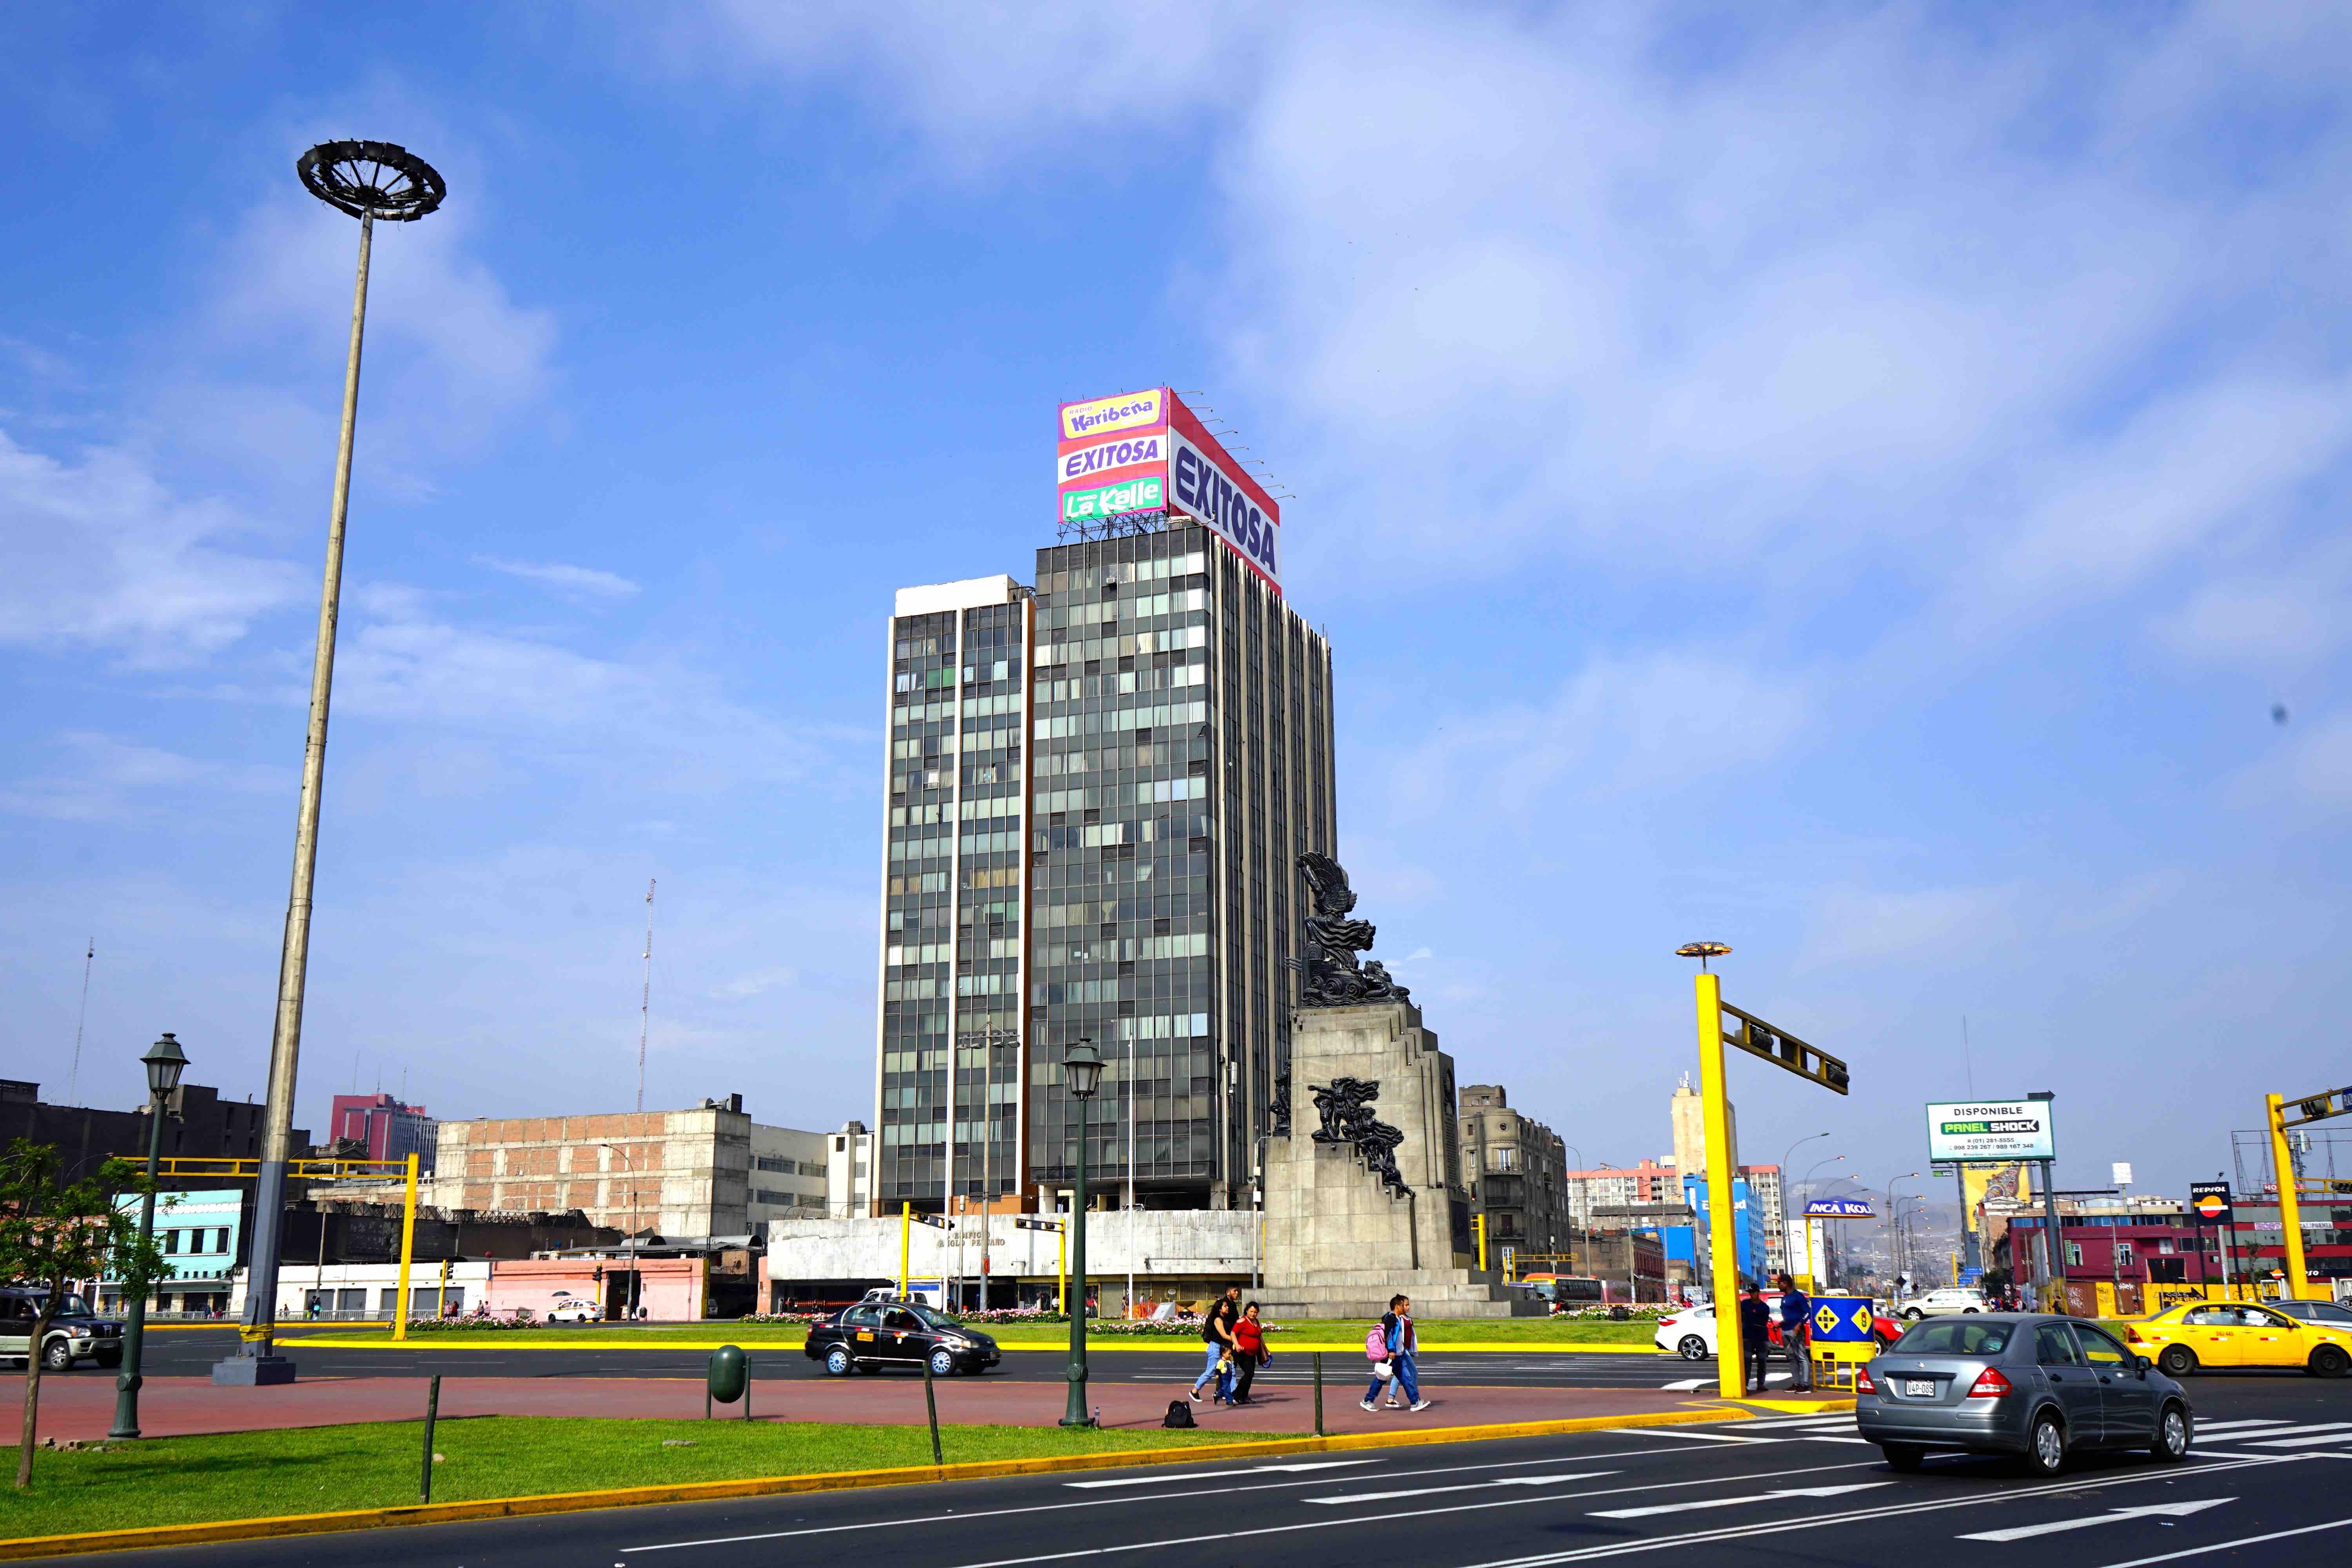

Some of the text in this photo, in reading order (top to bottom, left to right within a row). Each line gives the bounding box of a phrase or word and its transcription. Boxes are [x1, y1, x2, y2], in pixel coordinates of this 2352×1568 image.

[1069, 406, 1092, 414] RADIO
[1071, 401, 1152, 432] Karibeña
[1066, 439, 1158, 477] EXITOSA
[1066, 481, 1158, 517] La Kalle
[1176, 446, 1276, 575] EXITOSA
[1954, 1107, 2023, 1116] DISPONIBLE
[1945, 1120, 2036, 1132] PANEL SHOCK
[1809, 1203, 1841, 1213] INCA
[1908, 1384, 1933, 1393] V4P-085
